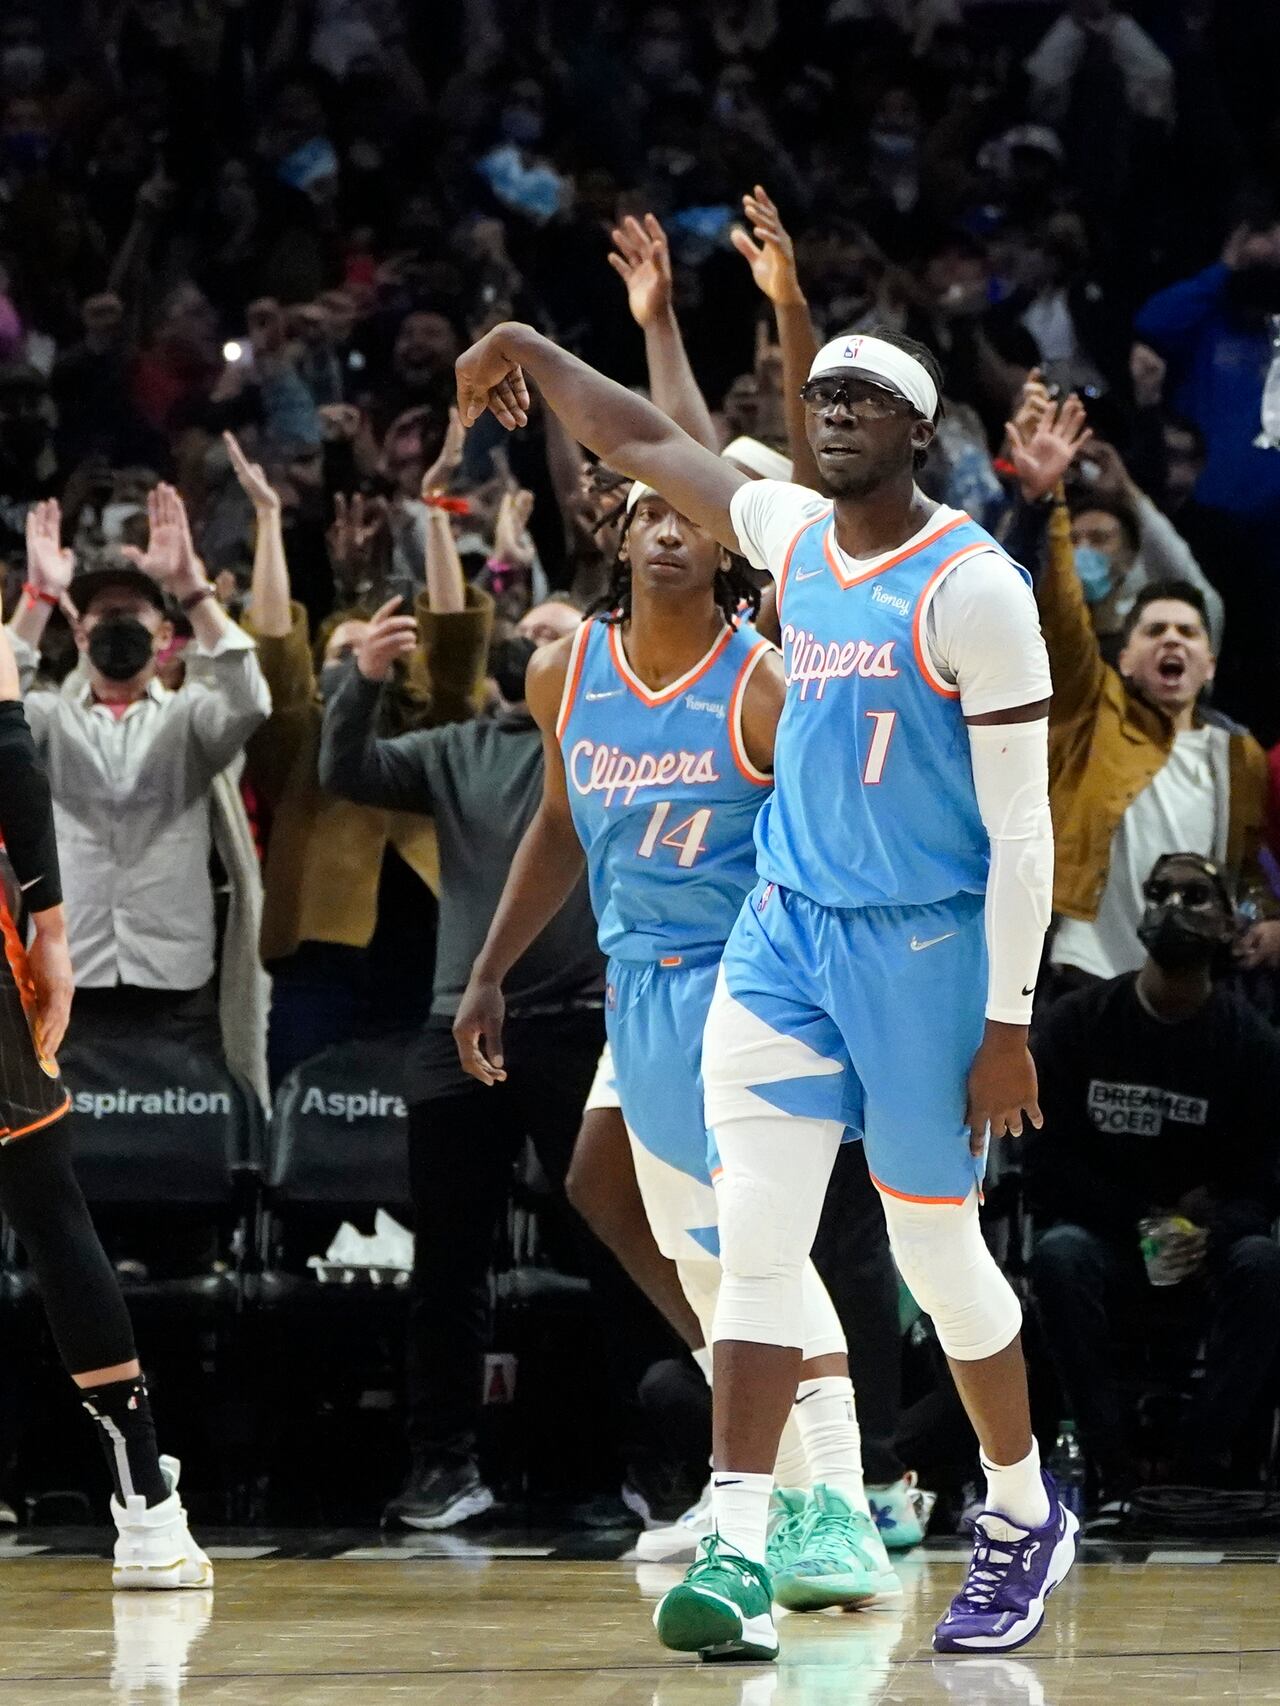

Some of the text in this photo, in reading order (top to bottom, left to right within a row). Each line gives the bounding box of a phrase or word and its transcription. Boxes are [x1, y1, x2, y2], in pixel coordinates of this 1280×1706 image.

[872, 584, 911, 616] honey
[783, 624, 898, 701] Clippers
[685, 693, 727, 718] honey
[569, 739, 720, 807] Clippers
[864, 711, 897, 785] 1
[636, 801, 713, 868] 14
[70, 1086, 230, 1119] spiration
[1090, 1106, 1155, 1133] DOER
